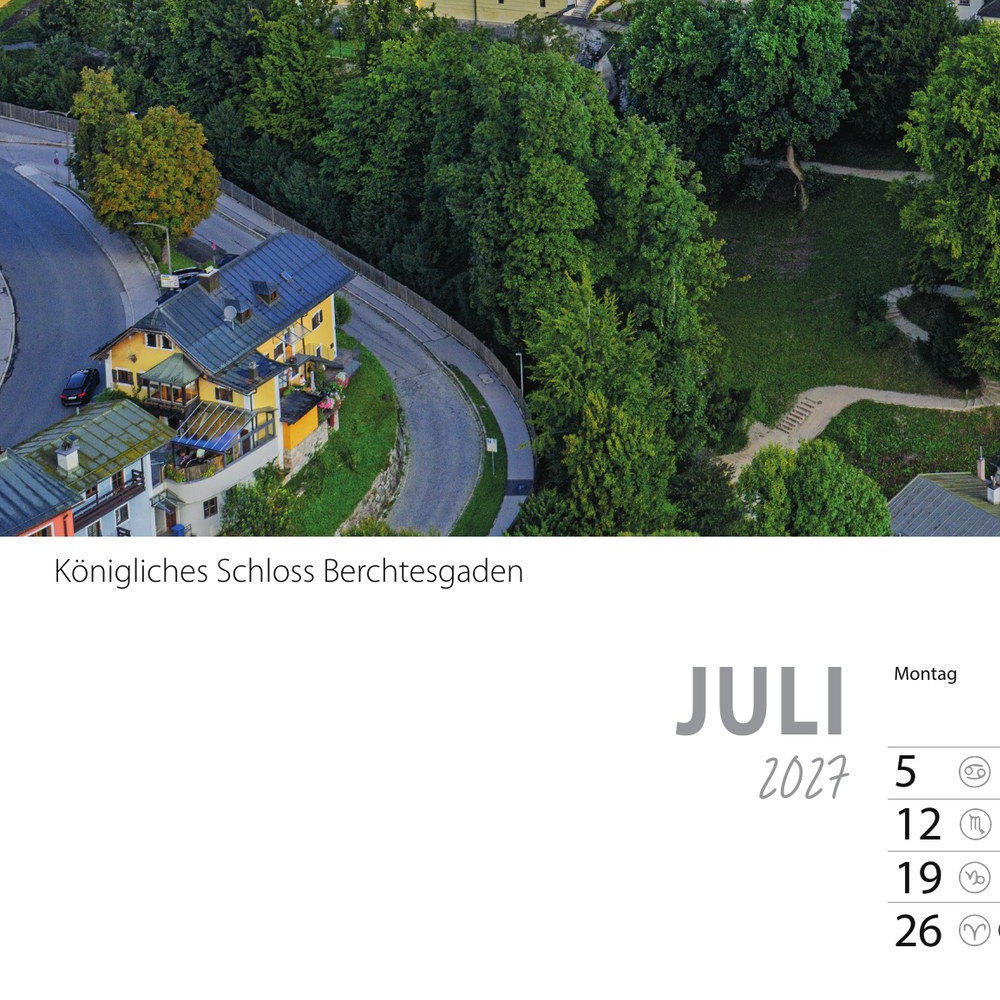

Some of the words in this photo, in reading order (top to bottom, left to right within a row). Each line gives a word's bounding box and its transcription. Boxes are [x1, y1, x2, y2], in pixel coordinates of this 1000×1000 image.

[894, 666, 957, 685] Montag
[675, 666, 842, 736] JULI
[759, 754, 850, 800] 2027
[895, 754, 916, 788] 5
[898, 806, 942, 841] 12
[898, 860, 942, 895] 19
[895, 913, 942, 948] 26
